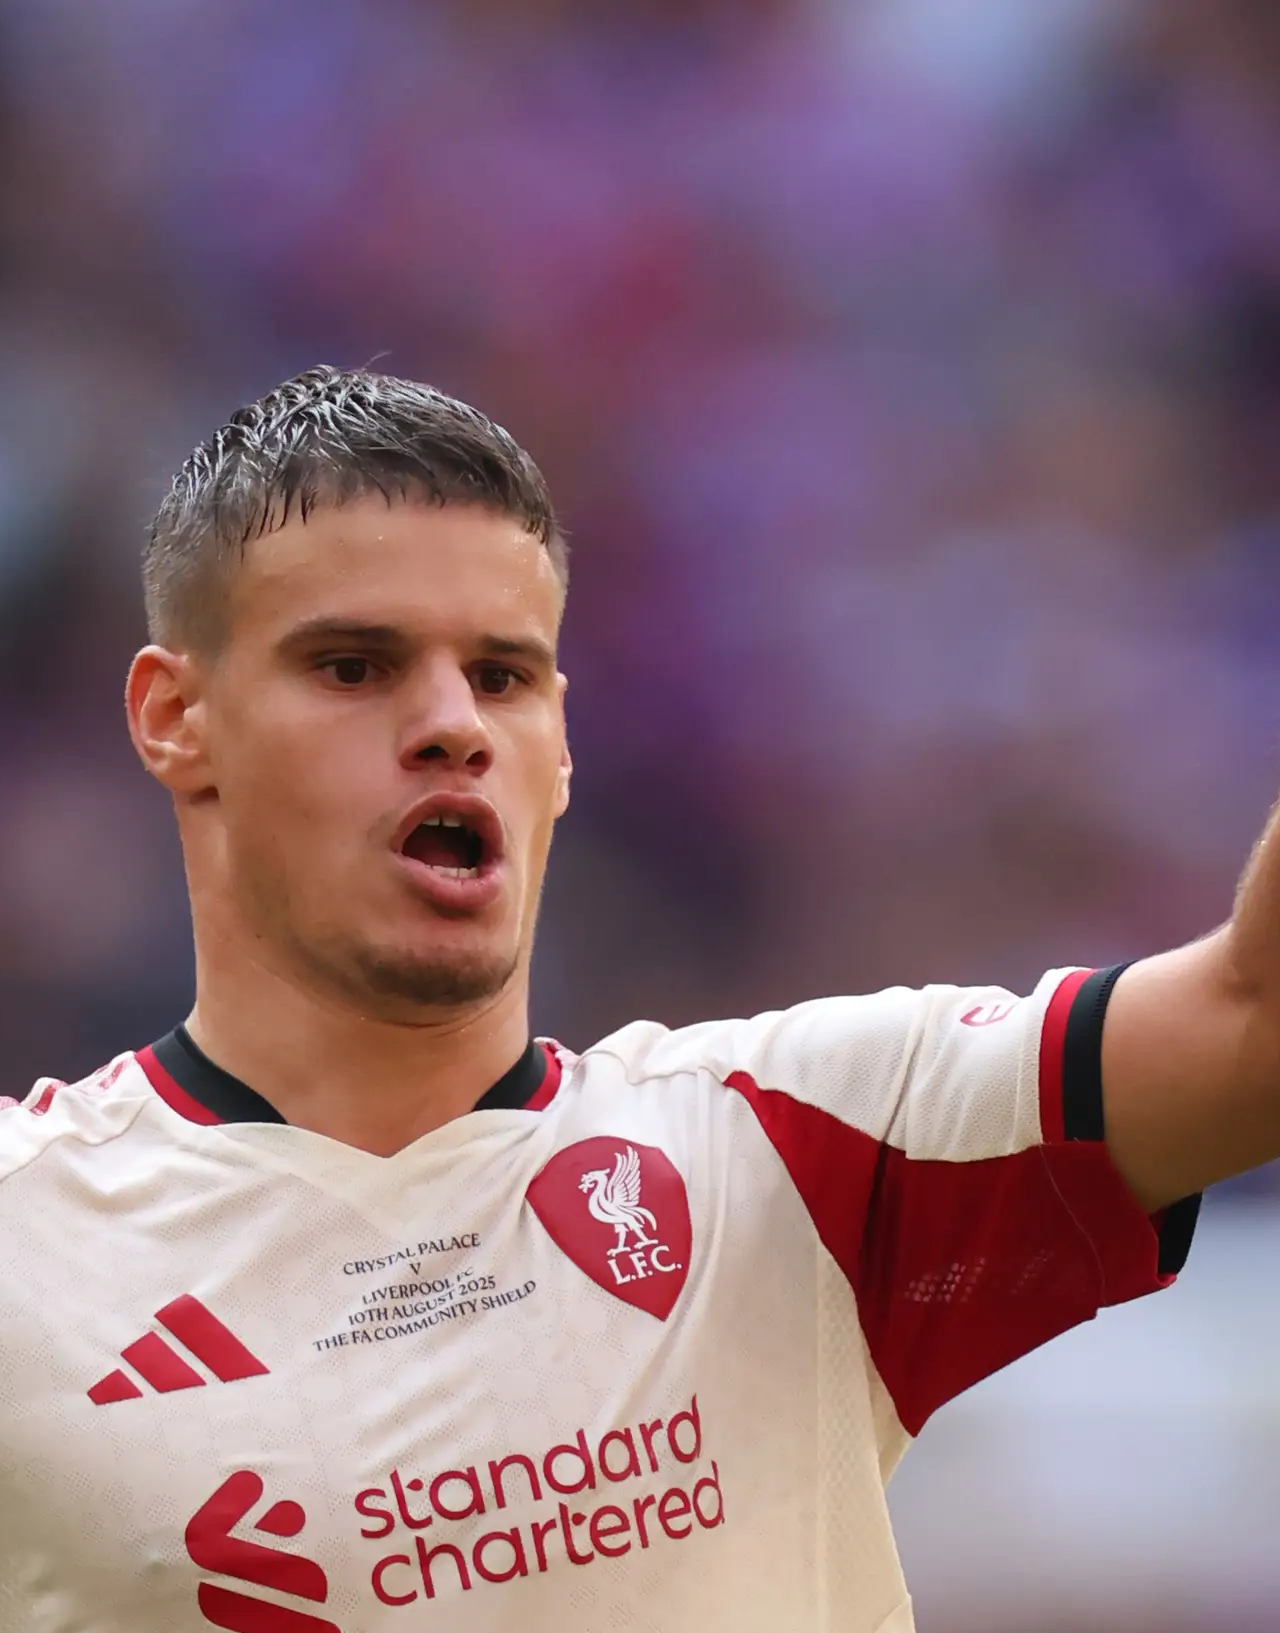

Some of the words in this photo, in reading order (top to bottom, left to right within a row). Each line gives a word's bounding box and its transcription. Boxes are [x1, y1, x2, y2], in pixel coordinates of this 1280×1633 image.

[343, 1247, 415, 1275] CRYSTAL
[418, 1233, 481, 1256] PALACE
[607, 1245, 682, 1285] L.F.C.
[313, 1333, 350, 1351] THE
[351, 1328, 373, 1344] FA
[374, 1298, 477, 1341] COMMUNITY
[480, 1280, 536, 1310] SHIELD
[348, 1307, 389, 1325] 10TH
[392, 1289, 456, 1320] AUGUST
[459, 1275, 496, 1296] 2025
[362, 1279, 454, 1304] LIVERPOOL
[354, 1393, 703, 1540] standard
[370, 1460, 726, 1607] chartered
